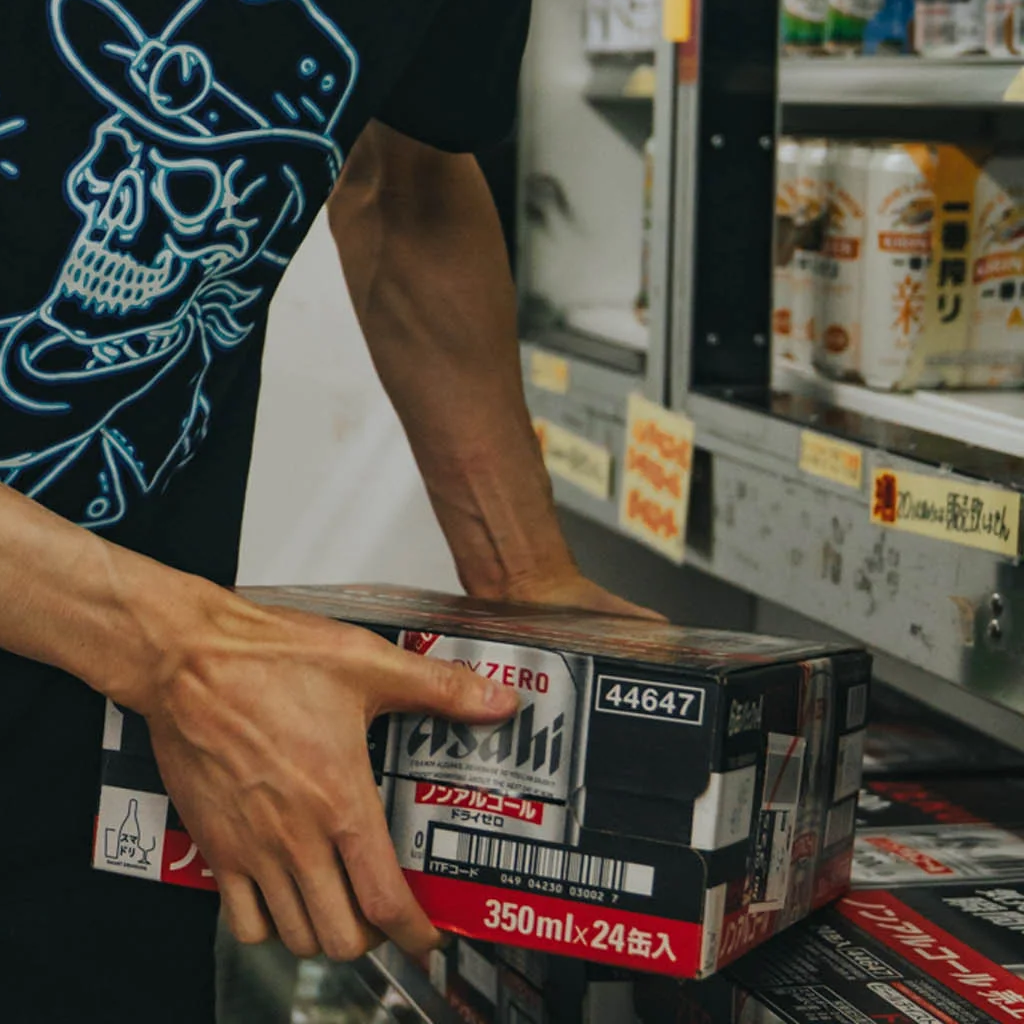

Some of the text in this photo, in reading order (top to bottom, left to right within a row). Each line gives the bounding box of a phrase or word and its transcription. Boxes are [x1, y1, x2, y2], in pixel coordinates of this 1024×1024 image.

[485, 662, 549, 694] ZERO
[605, 683, 695, 716] 44647
[407, 703, 564, 775] Asahi
[421, 784, 537, 819] ノンアルコール
[451, 808, 504, 827] ドライゼロ
[120, 833, 138, 844] スマ
[414, 831, 424, 849] 0
[120, 845, 135, 858] ドリ
[429, 860, 480, 877] ITFコード
[500, 873, 619, 904] 049 04230 03002 7
